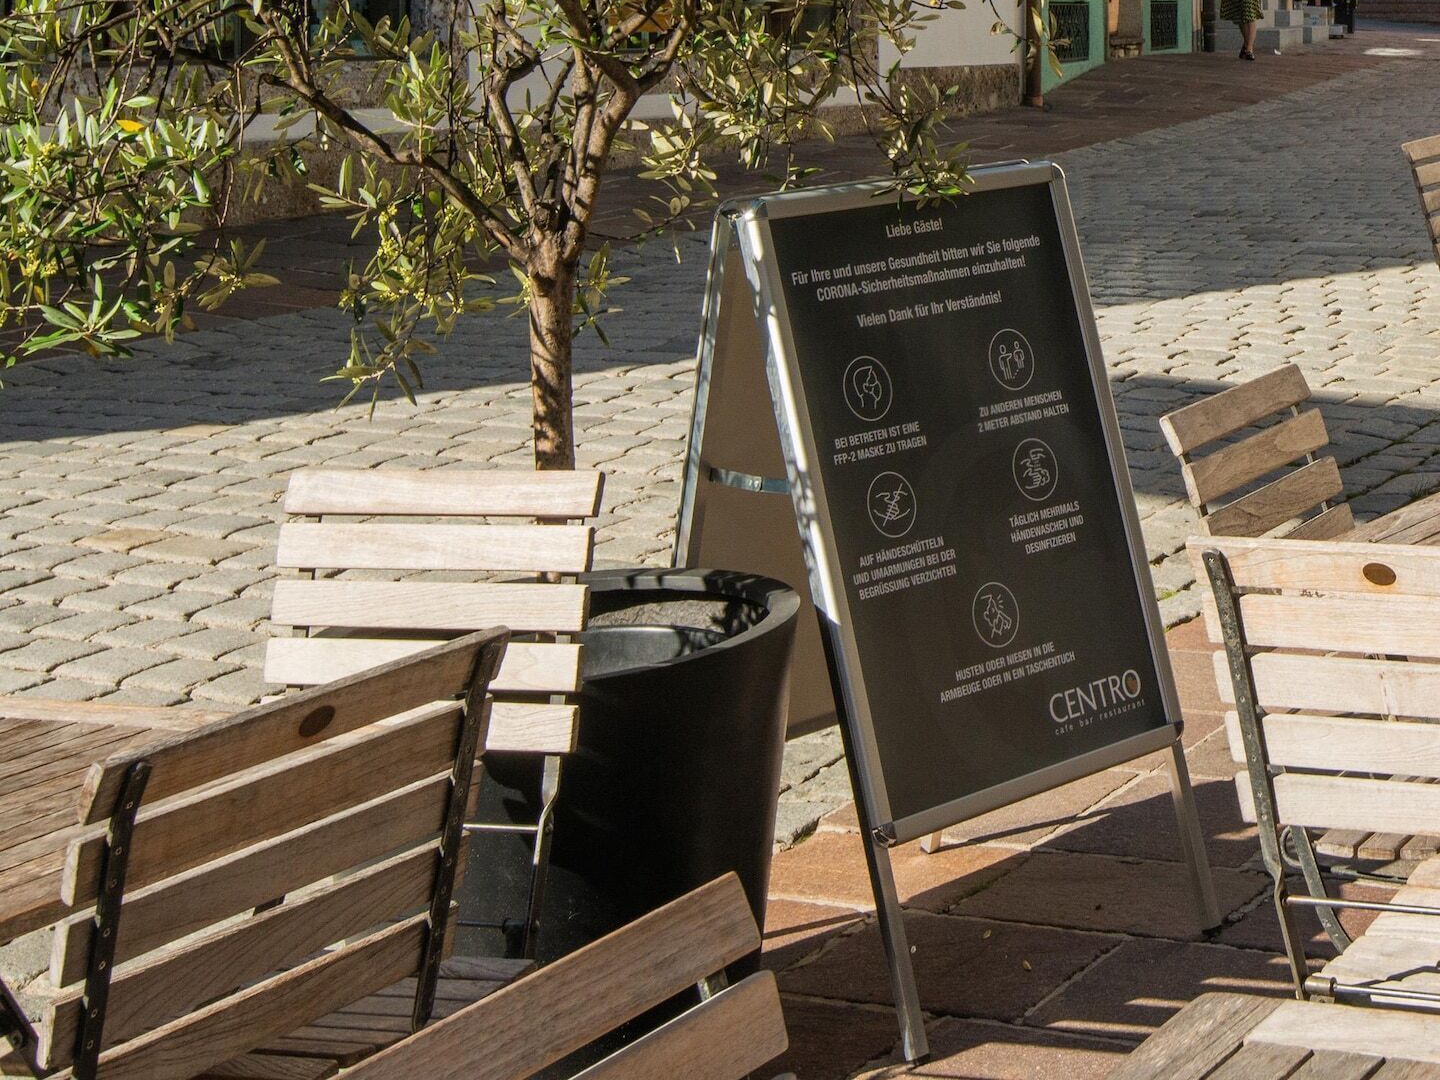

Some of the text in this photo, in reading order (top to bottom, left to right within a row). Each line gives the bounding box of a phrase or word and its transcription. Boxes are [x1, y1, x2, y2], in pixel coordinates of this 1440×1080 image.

[886, 218, 943, 238] Liebe Gäste!
[792, 235, 1040, 286] Für Ihre und unsere Gesundheit bitten wir Sie folgende
[817, 255, 1026, 301] CORONA-Sicherheitsmaßnahmen einzuhalten!
[857, 291, 1002, 327] Vielen Dank für Ihr Verständnis!
[978, 403, 1069, 432] 2 METER ABSTAND HALTEN
[979, 390, 1062, 417] ZU ANDEREN MENSCHEN
[834, 436, 927, 465] FFP-2 MASKE ZU TRAGEN
[835, 421, 920, 449] BEI BETRETEN IST EINE
[1009, 501, 1080, 528] TÄGLICH MEHRMALS
[1011, 515, 1084, 542] HÄNDEWASCHEN UND
[859, 536, 944, 568] AUF HÄNDESCHÜTTELN
[1025, 532, 1076, 554] DESINFIZIEREN
[853, 549, 956, 585] UND UMARMUNGEN BEI DER
[859, 565, 957, 600] BEGRÜSSUNG VERZICHTEN
[940, 651, 1075, 703] ARMBEUGE ODER IN EIN TASCHENTUCH
[956, 642, 1055, 681] HUSTEN ODER NIESEN IN DIE
[1049, 669, 1141, 723] CENTRO
[1055, 699, 1145, 736] cafe bar restaurant
